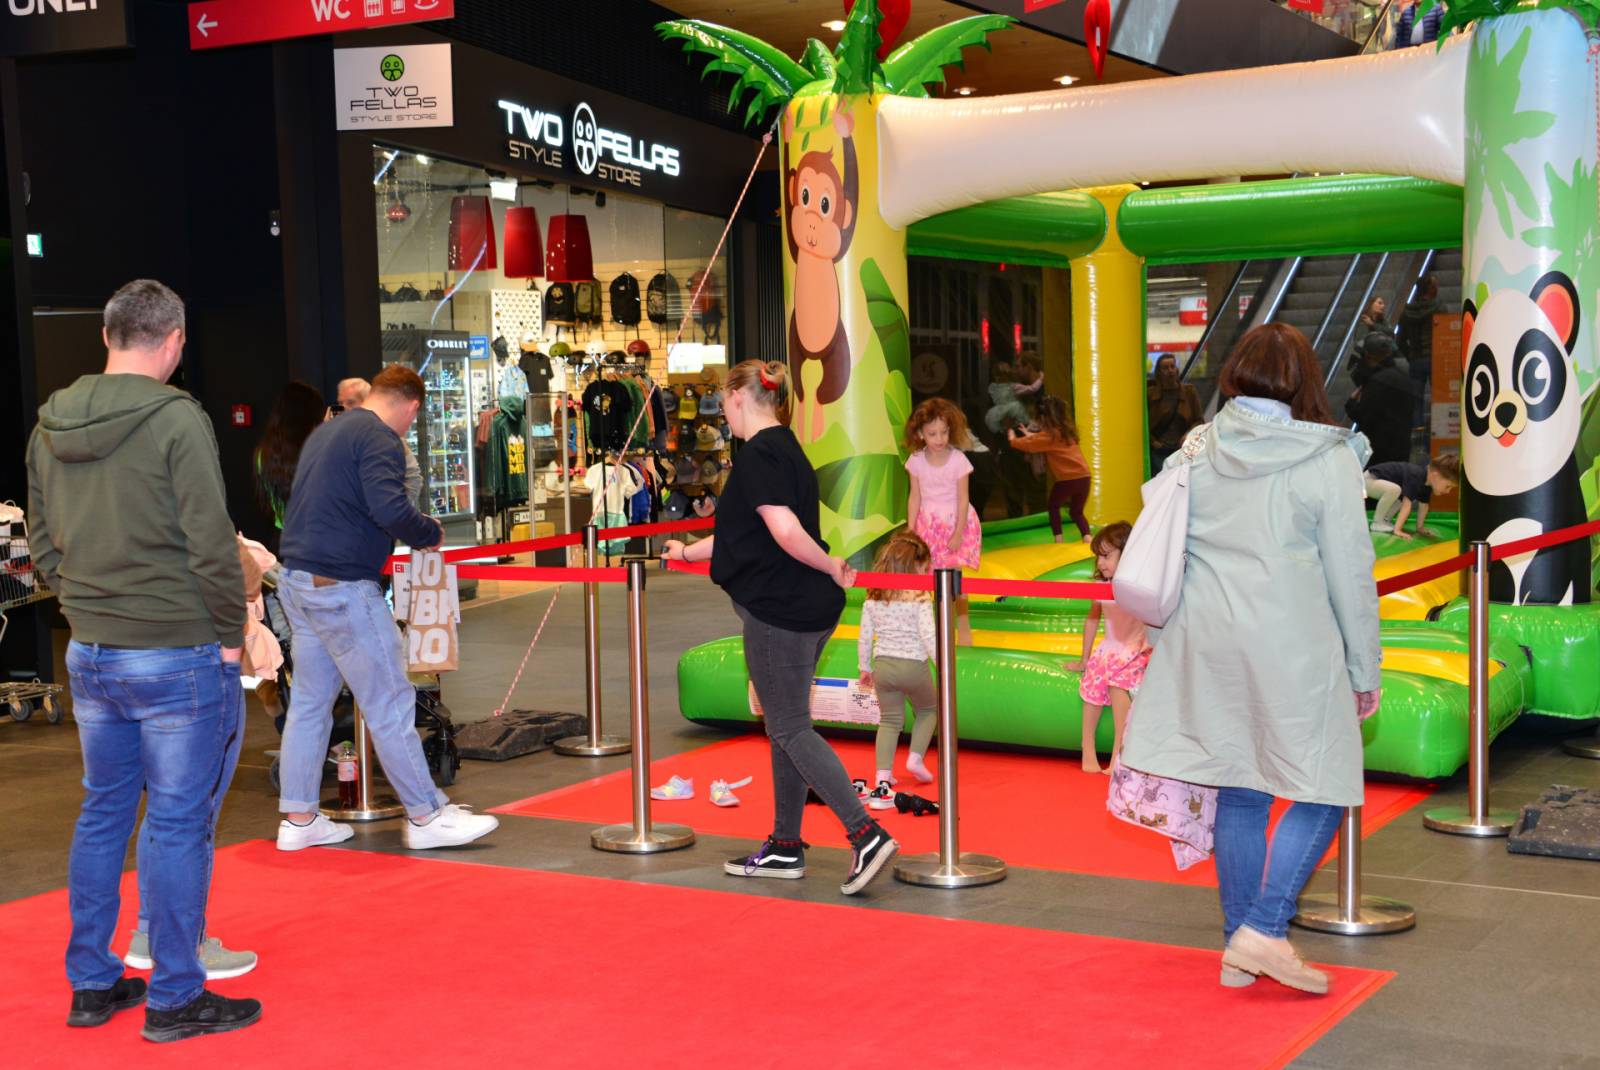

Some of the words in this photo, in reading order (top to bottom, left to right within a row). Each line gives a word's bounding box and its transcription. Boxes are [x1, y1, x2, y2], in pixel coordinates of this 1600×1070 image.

[311, 0, 351, 22] WC
[365, 86, 419, 98] TWO
[350, 97, 437, 111] FELLAS
[350, 115, 392, 123] STYLE
[396, 113, 437, 121] STORE
[498, 100, 563, 147] TWO
[597, 127, 680, 177] FELLAS
[508, 140, 562, 168] STYLE
[598, 163, 641, 187] STORE
